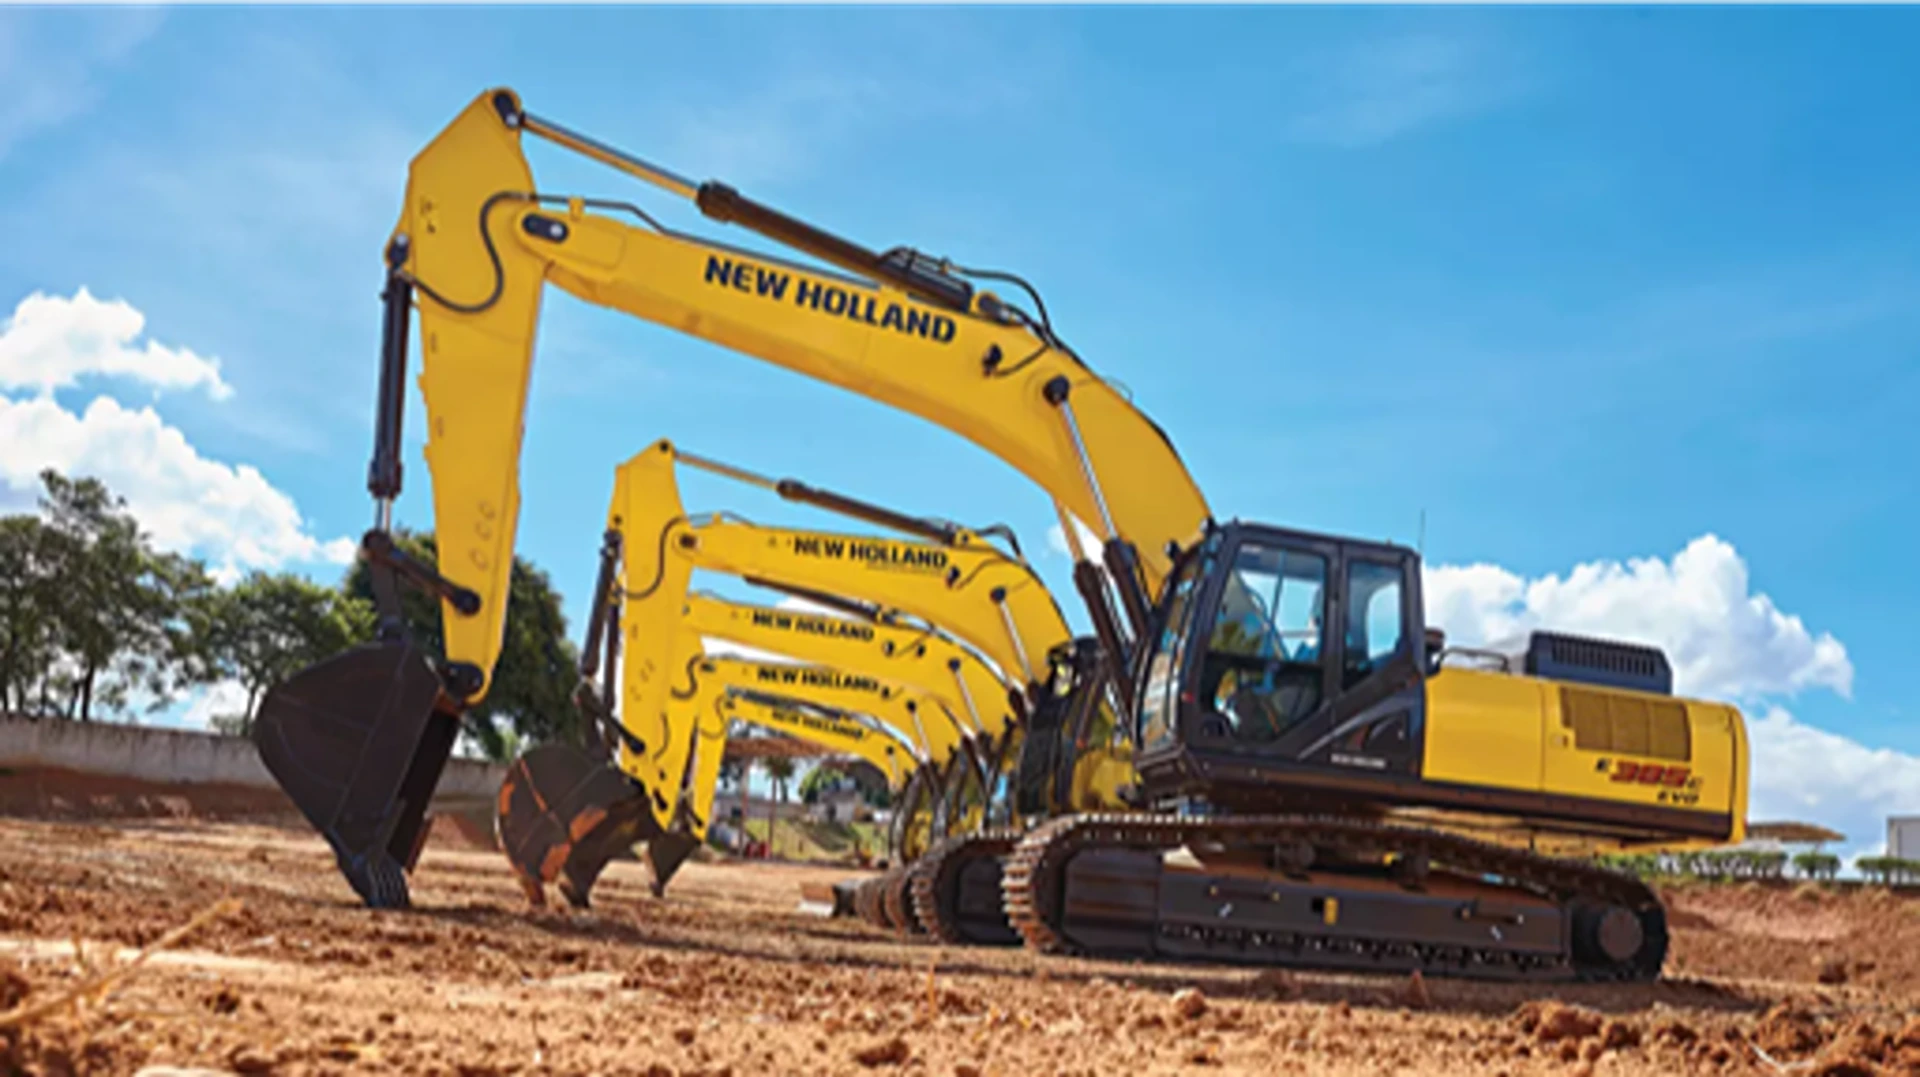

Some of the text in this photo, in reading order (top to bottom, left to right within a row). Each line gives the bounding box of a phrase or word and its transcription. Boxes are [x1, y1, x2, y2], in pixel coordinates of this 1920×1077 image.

[704, 254, 957, 344] NEW HOLLAND
[794, 536, 947, 568] NEW HOLLAND
